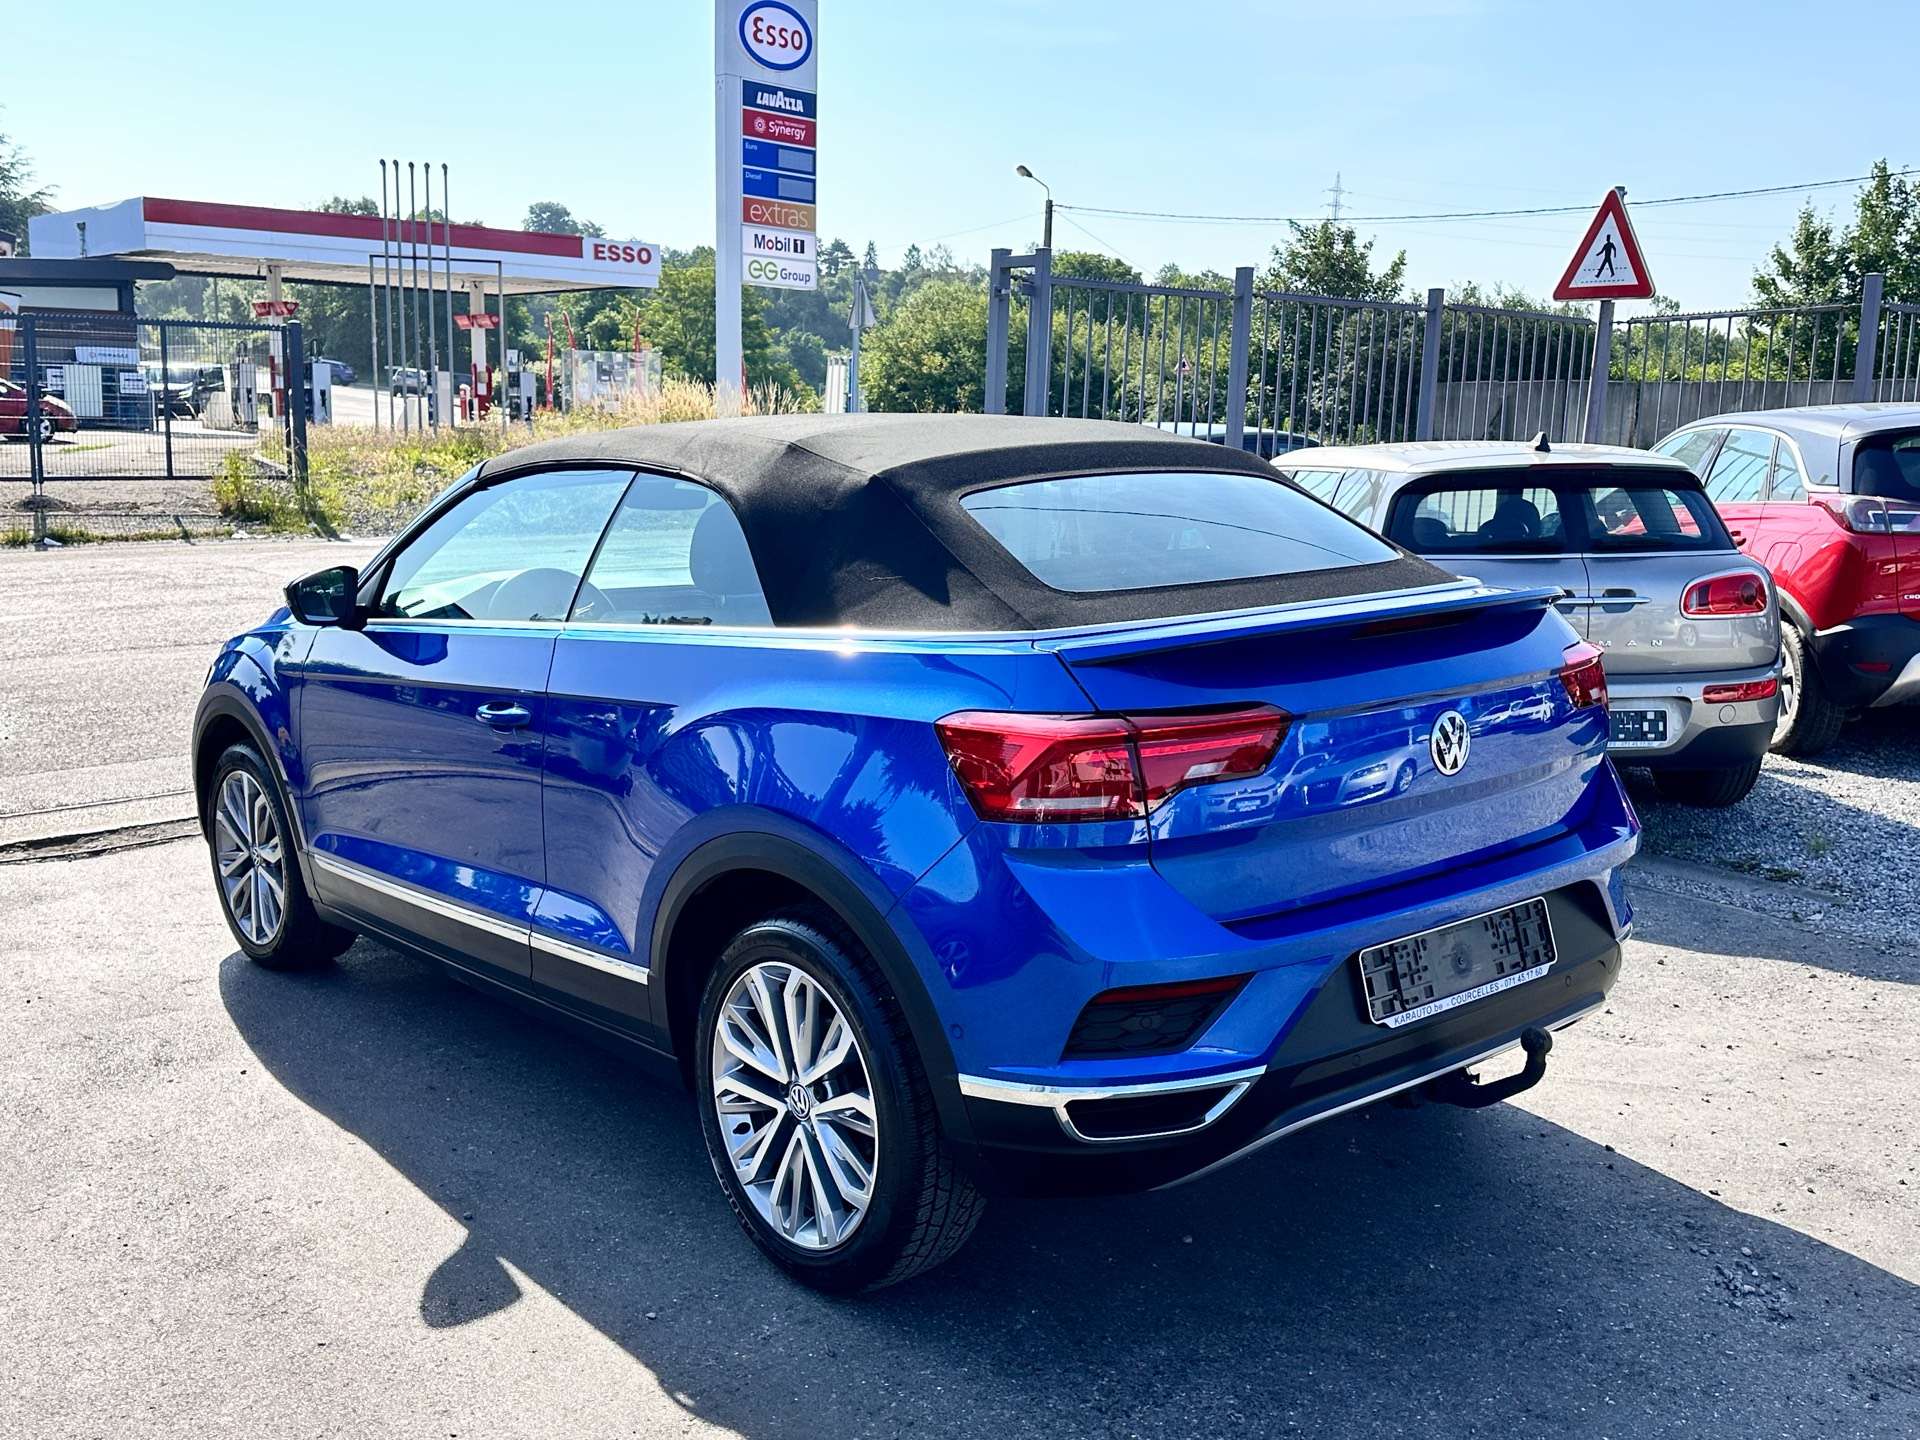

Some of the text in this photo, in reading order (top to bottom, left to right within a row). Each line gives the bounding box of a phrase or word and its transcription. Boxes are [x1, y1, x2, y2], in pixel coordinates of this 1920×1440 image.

[756, 91, 804, 113] LAVAZZA
[768, 121, 806, 141] Synergy
[750, 203, 809, 228] extras
[593, 243, 652, 265] ESSO
[754, 233, 791, 253] Mobil
[780, 268, 811, 285] Group
[1450, 982, 1500, 1006] COURCELLES
